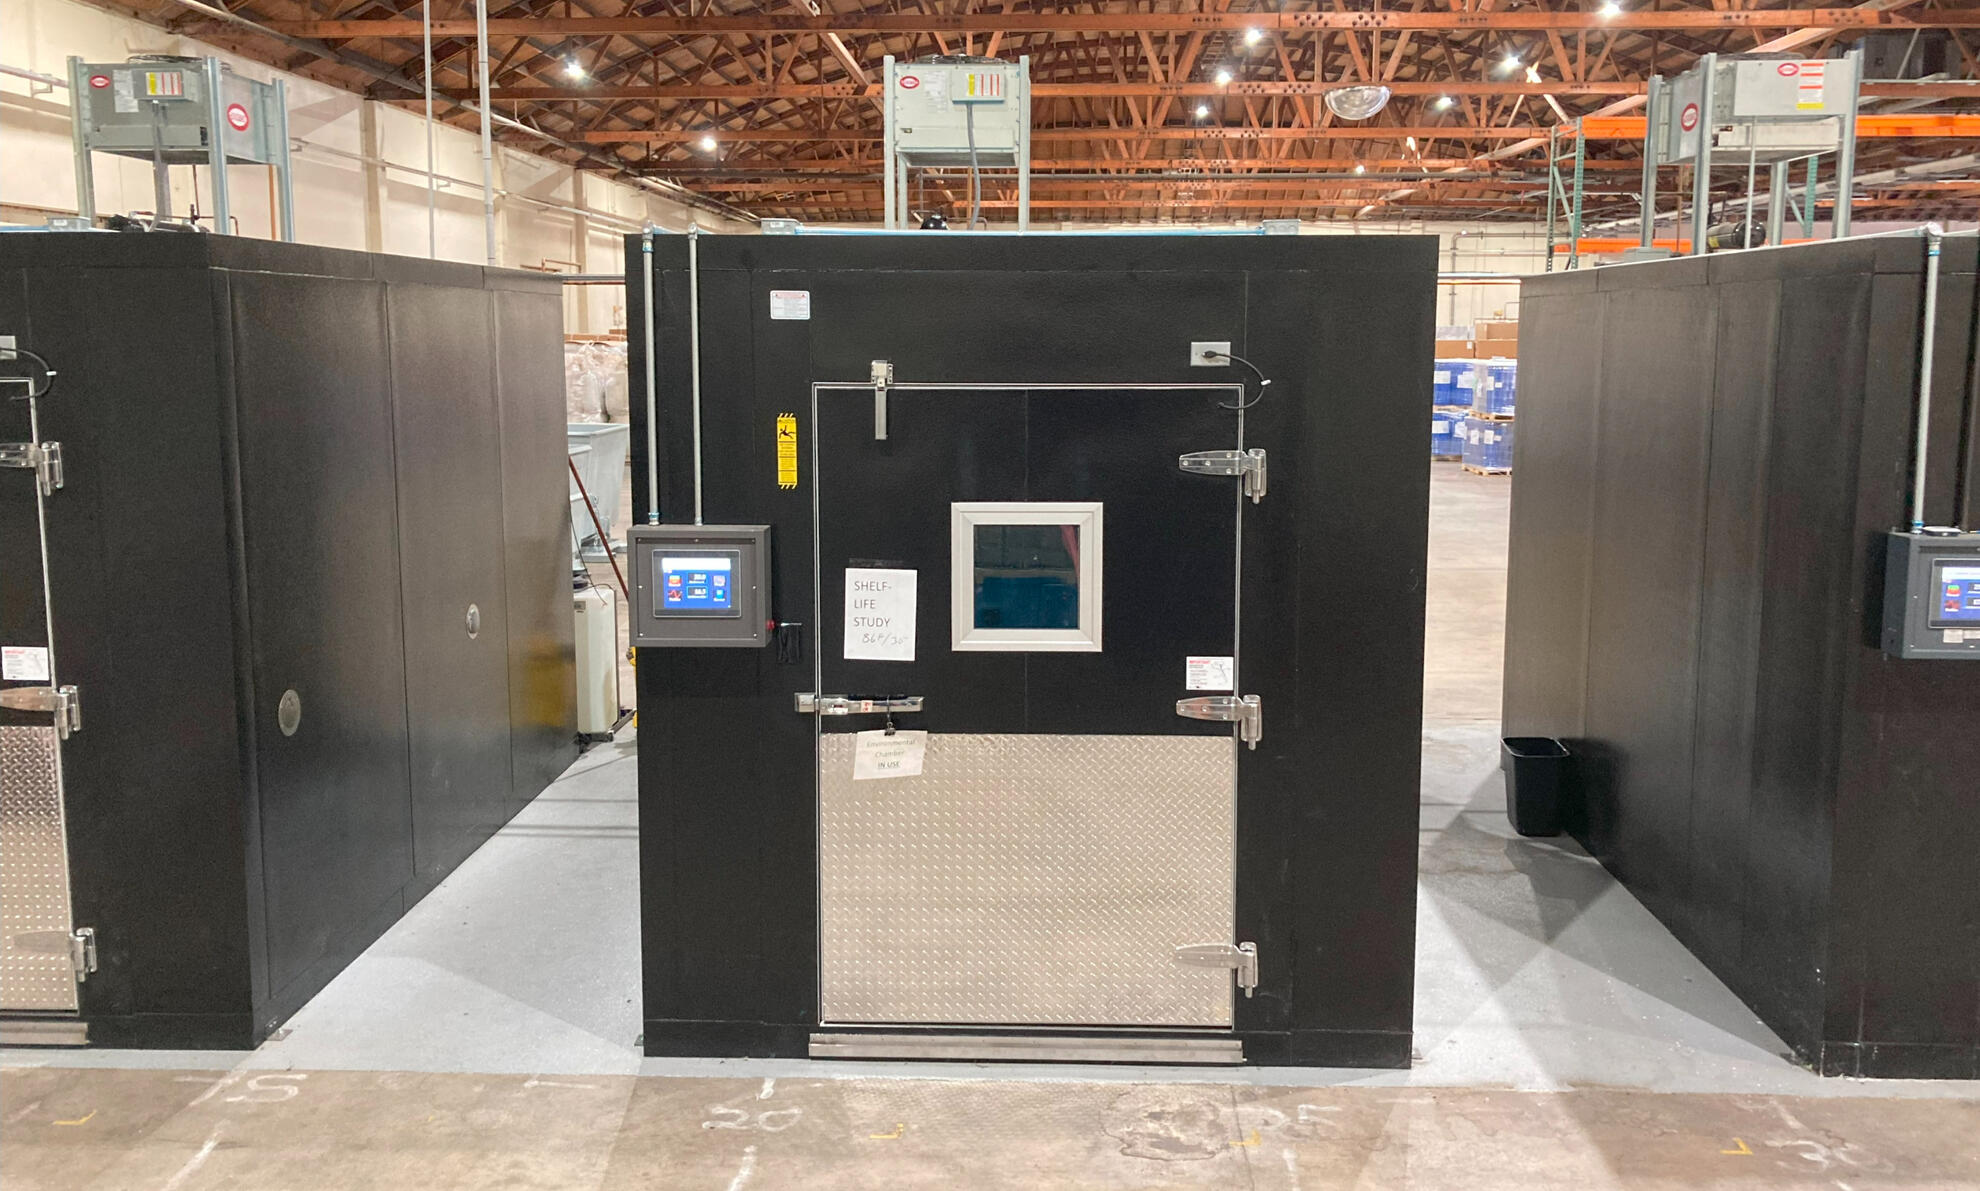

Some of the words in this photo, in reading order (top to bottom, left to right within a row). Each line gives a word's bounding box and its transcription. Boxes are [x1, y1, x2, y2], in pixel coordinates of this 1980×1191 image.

[854, 580, 892, 592] SHELF-
[854, 599, 876, 609] LIFE
[853, 617, 890, 628] STUDY
[867, 739, 915, 748] Environmental
[875, 750, 905, 758] Chamber
[887, 760, 900, 769] USE
[702, 1104, 803, 1133] 20
